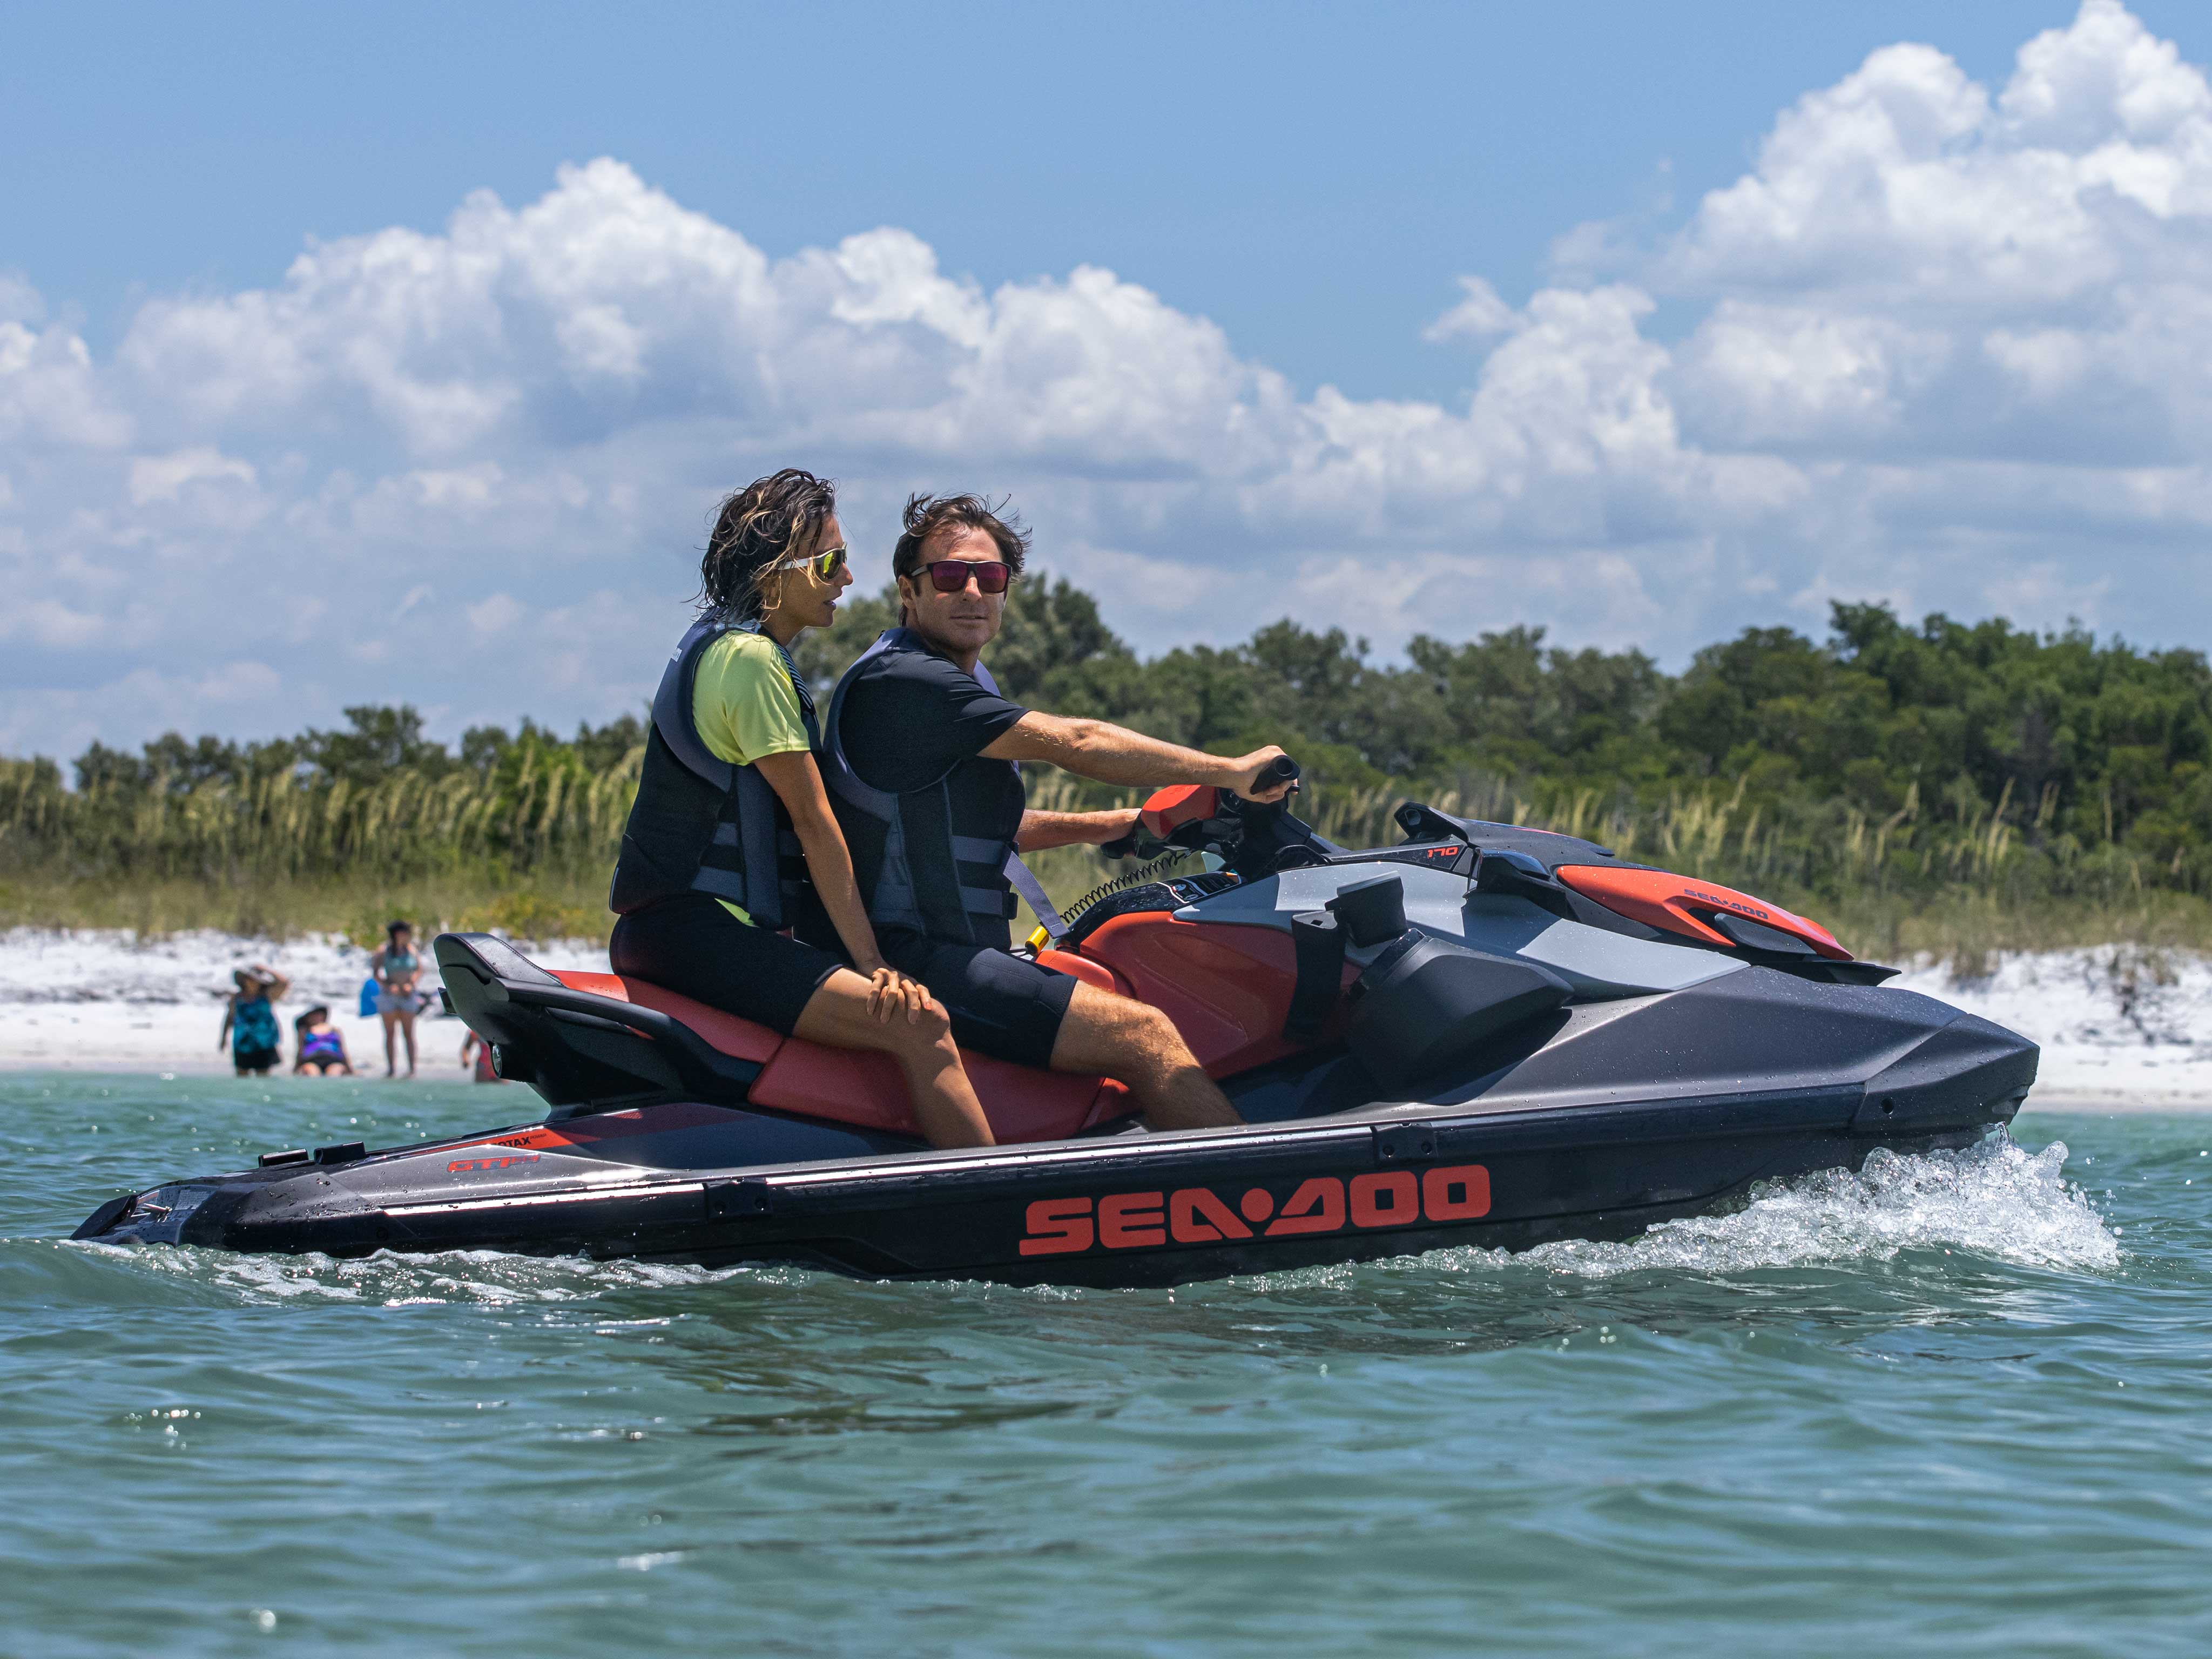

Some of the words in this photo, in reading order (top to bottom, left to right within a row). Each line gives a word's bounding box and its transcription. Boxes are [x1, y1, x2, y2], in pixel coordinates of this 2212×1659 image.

[1427, 846, 1458, 858] 170
[493, 1136, 531, 1147] OTAX
[448, 1157, 510, 1172] GTI
